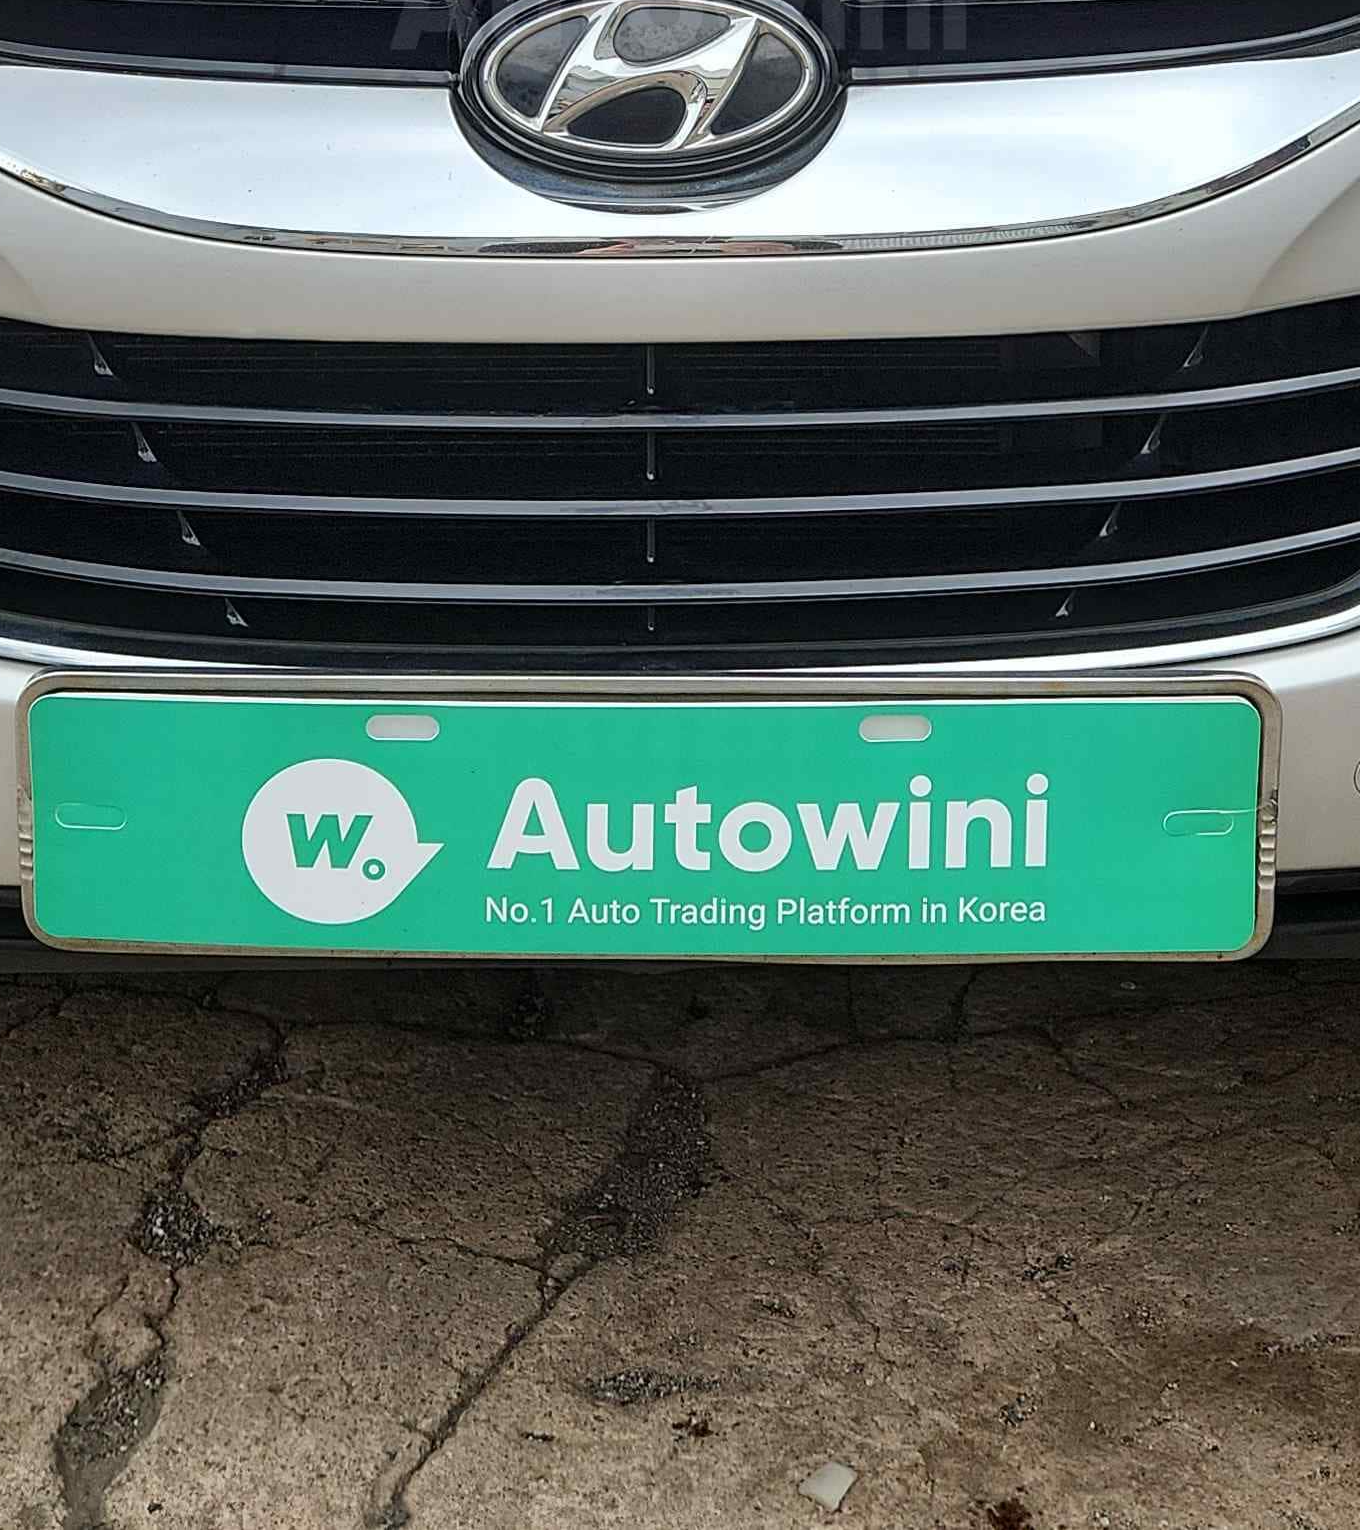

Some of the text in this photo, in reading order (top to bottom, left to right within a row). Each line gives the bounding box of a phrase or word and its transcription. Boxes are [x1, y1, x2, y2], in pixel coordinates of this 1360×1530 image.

[486, 773, 1049, 872] Autowini
[485, 896, 1047, 931] No.1 Auto Trading Platform in Korea
